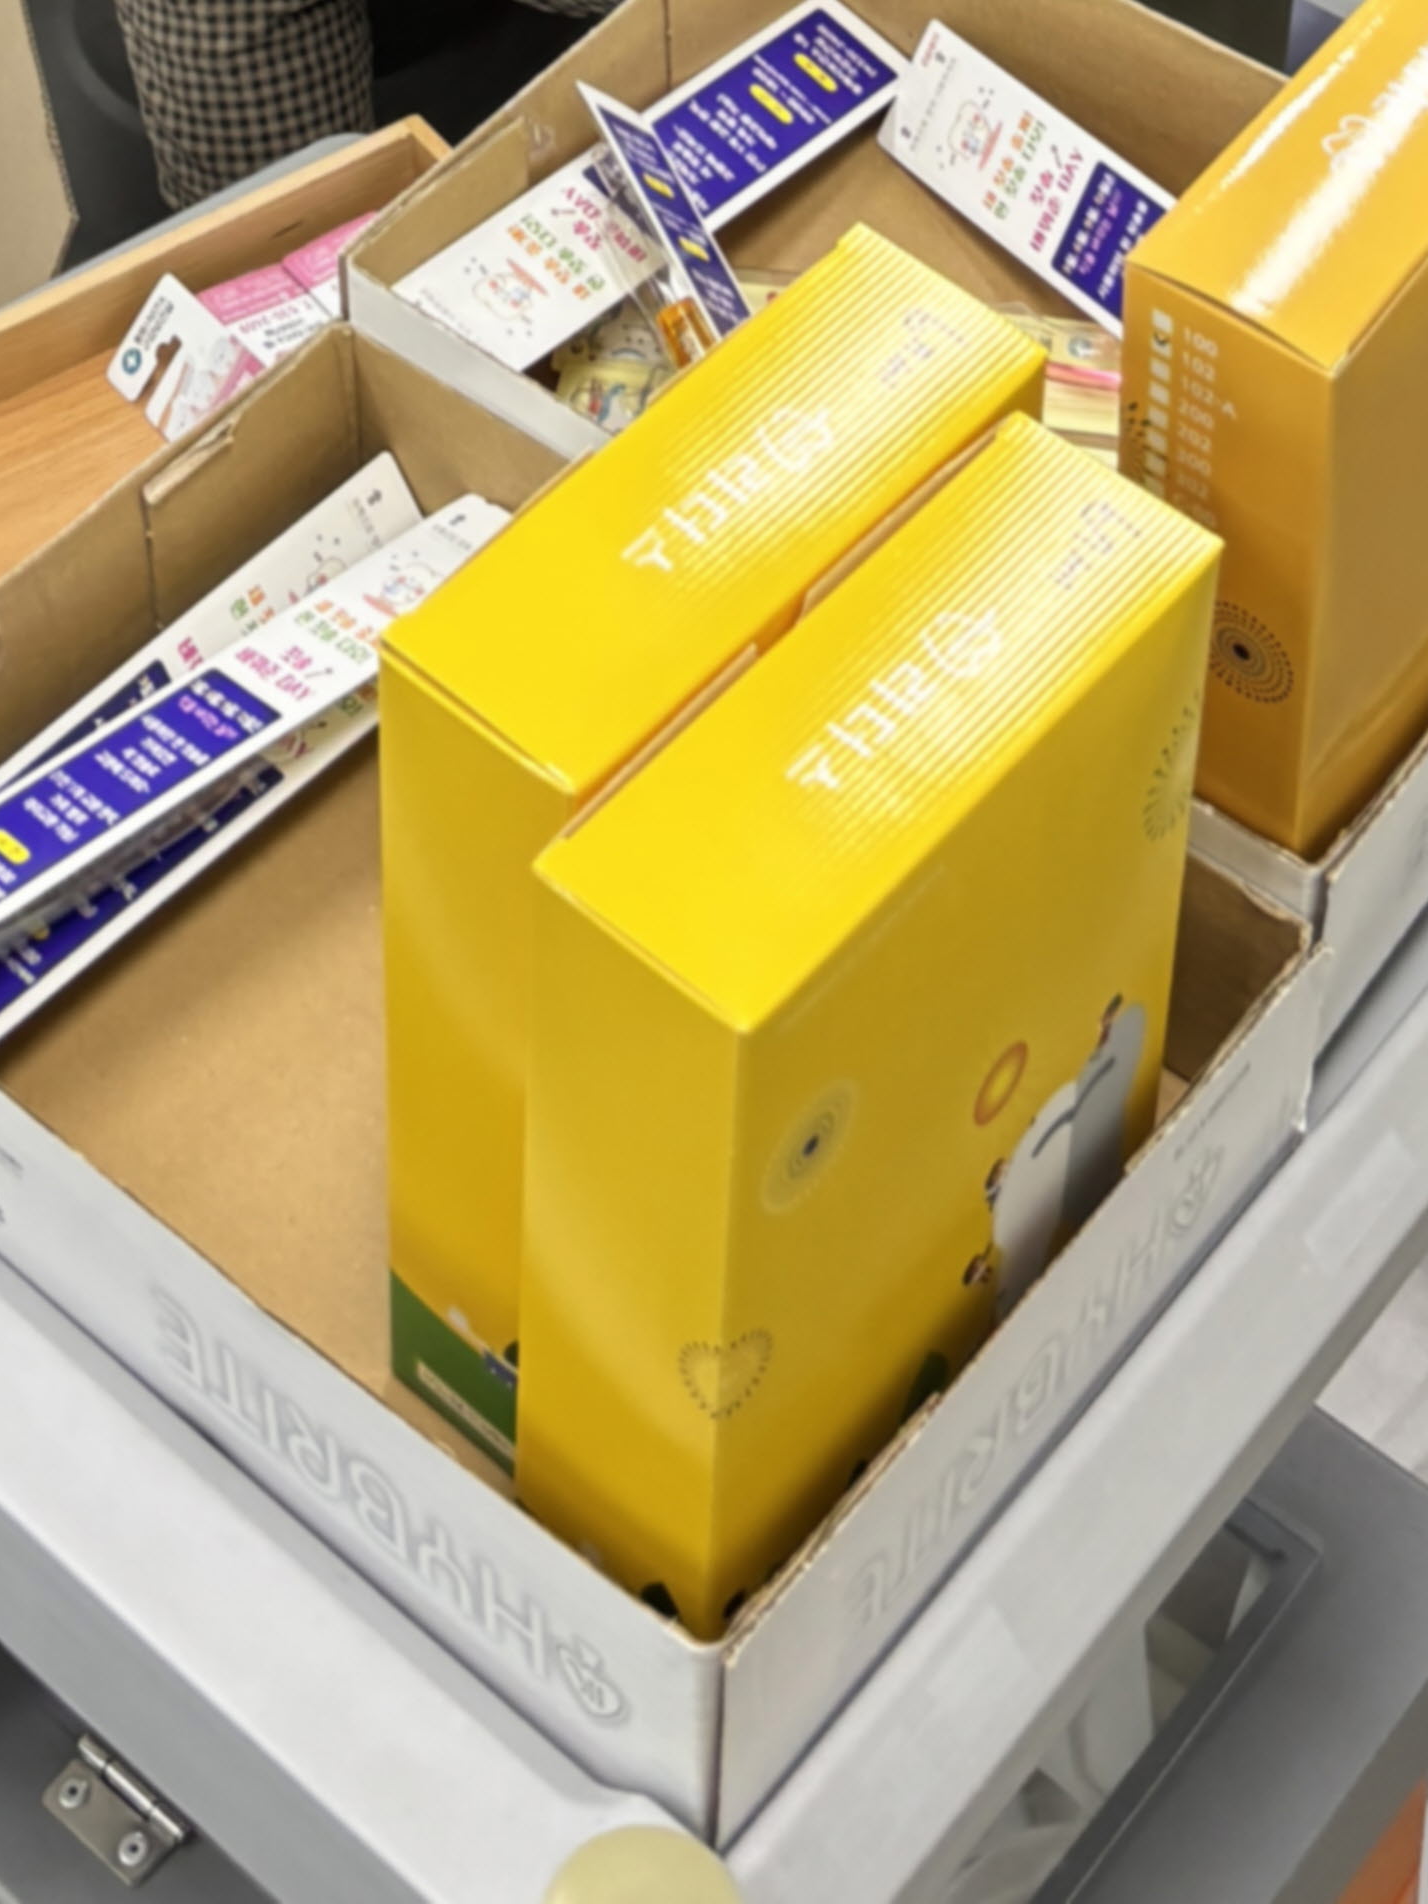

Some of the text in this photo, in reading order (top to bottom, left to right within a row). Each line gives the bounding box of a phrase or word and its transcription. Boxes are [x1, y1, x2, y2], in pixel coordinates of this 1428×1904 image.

[991, 155, 1014, 186] 칫솔
[1002, 164, 1027, 197] 칫솔
[1054, 147, 1085, 191] DAY
[1028, 168, 1055, 205] 칫솔
[559, 185, 602, 222] DAY
[569, 219, 605, 252] 칫솔
[540, 255, 572, 285] 칫솔
[554, 245, 588, 276] 칫솔
[1180, 326, 1221, 358] 100
[1177, 350, 1218, 382] 102
[620, 450, 766, 575] 리더스
[309, 617, 338, 644] 칫솔
[331, 607, 356, 631] 칫솔
[281, 643, 313, 674] 칫솔
[276, 671, 312, 703] DAY
[785, 658, 932, 790] 리더스
[851, 1225, 1177, 1624] HYBRITE
[149, 1286, 571, 1680] HYBRITE
